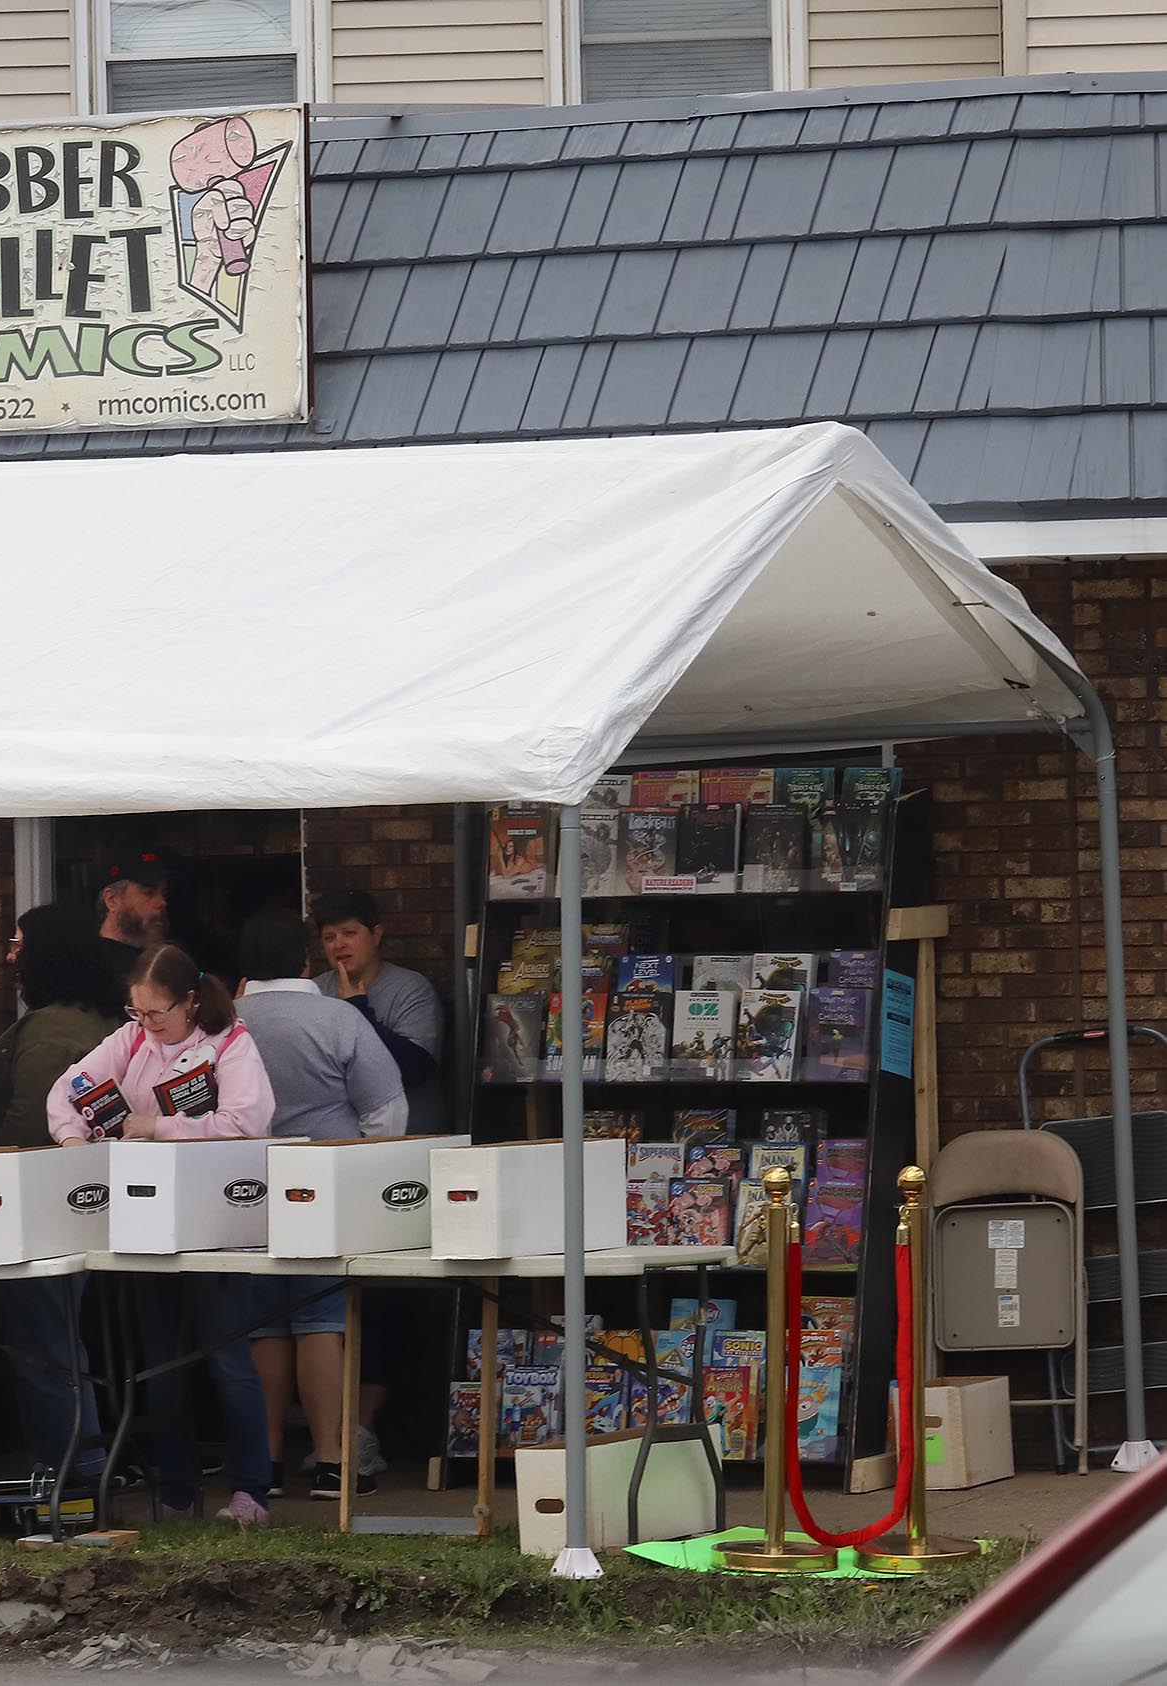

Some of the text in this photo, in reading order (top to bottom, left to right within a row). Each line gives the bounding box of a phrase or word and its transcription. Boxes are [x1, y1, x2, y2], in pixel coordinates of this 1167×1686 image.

[228, 352, 255, 372] LLC
[97, 390, 266, 416] rmcomics.com
[76, 1189, 105, 1204] BCW
[233, 1183, 261, 1200] BCW
[391, 1187, 420, 1202] BCW
[725, 1339, 763, 1351] SONIC
[505, 1371, 558, 1386] TOYBOX
